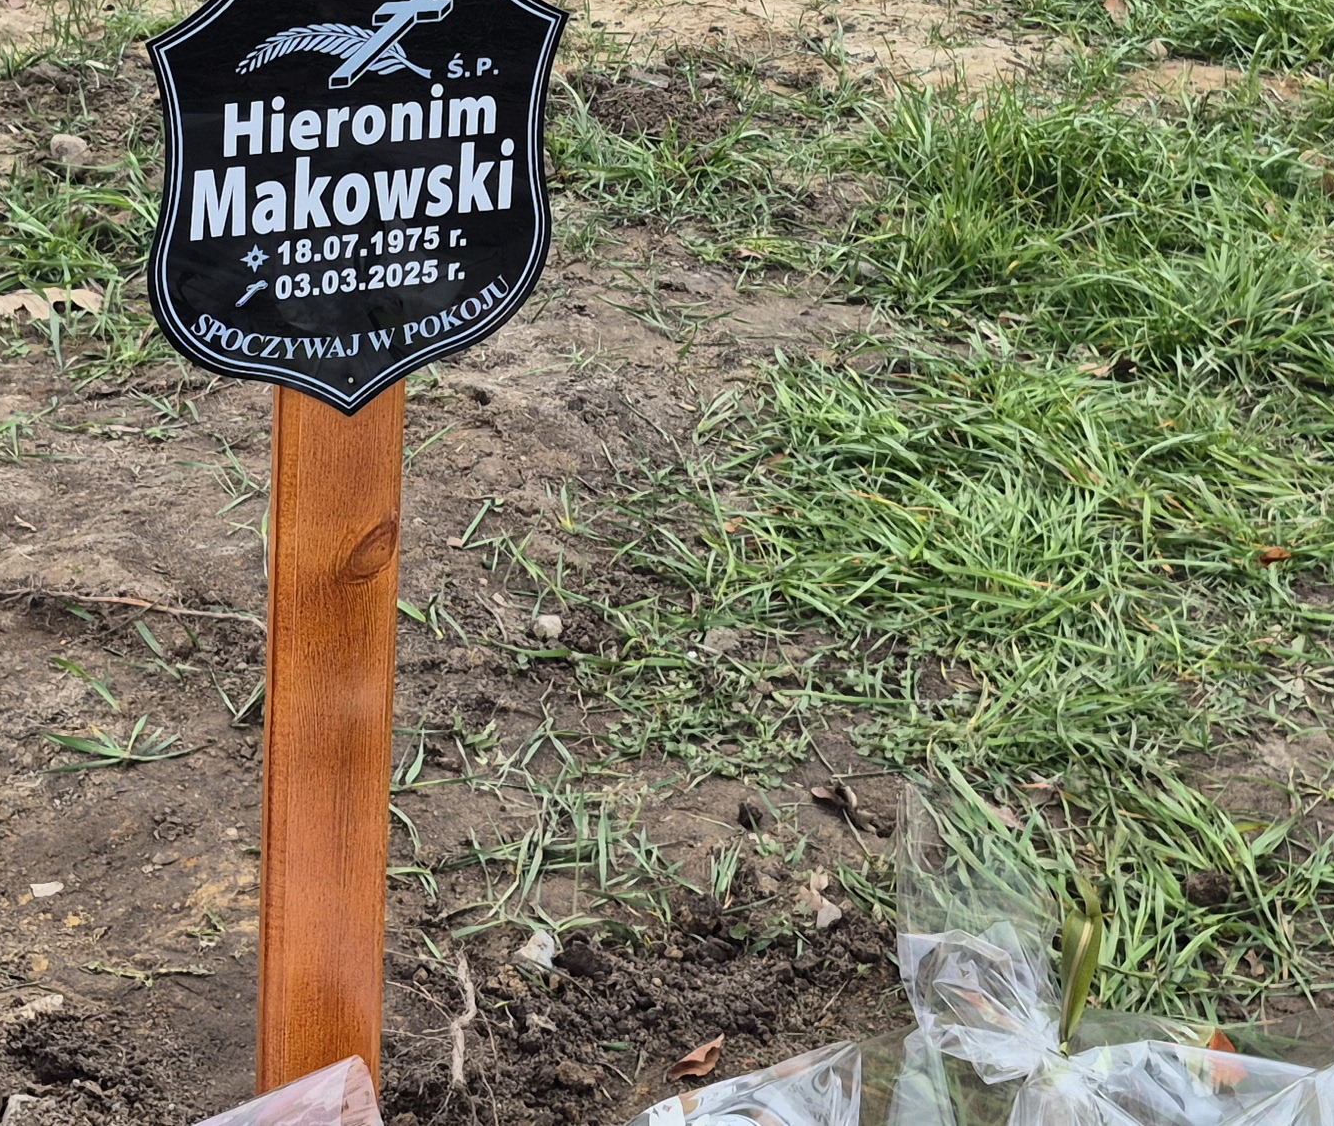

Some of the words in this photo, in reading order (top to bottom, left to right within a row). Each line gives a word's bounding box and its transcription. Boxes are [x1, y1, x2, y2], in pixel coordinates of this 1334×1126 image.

[223, 84, 497, 158] Hieronim
[189, 138, 515, 242] Makowski
[275, 261, 438, 300] 03.03.2025
[447, 265, 465, 282] r.
[277, 226, 440, 266] 18.07.1975
[450, 231, 467, 248] r.
[191, 314, 360, 360] SPOCZYWAJ
[368, 327, 397, 351] W
[404, 276, 510, 345] POKOJU
